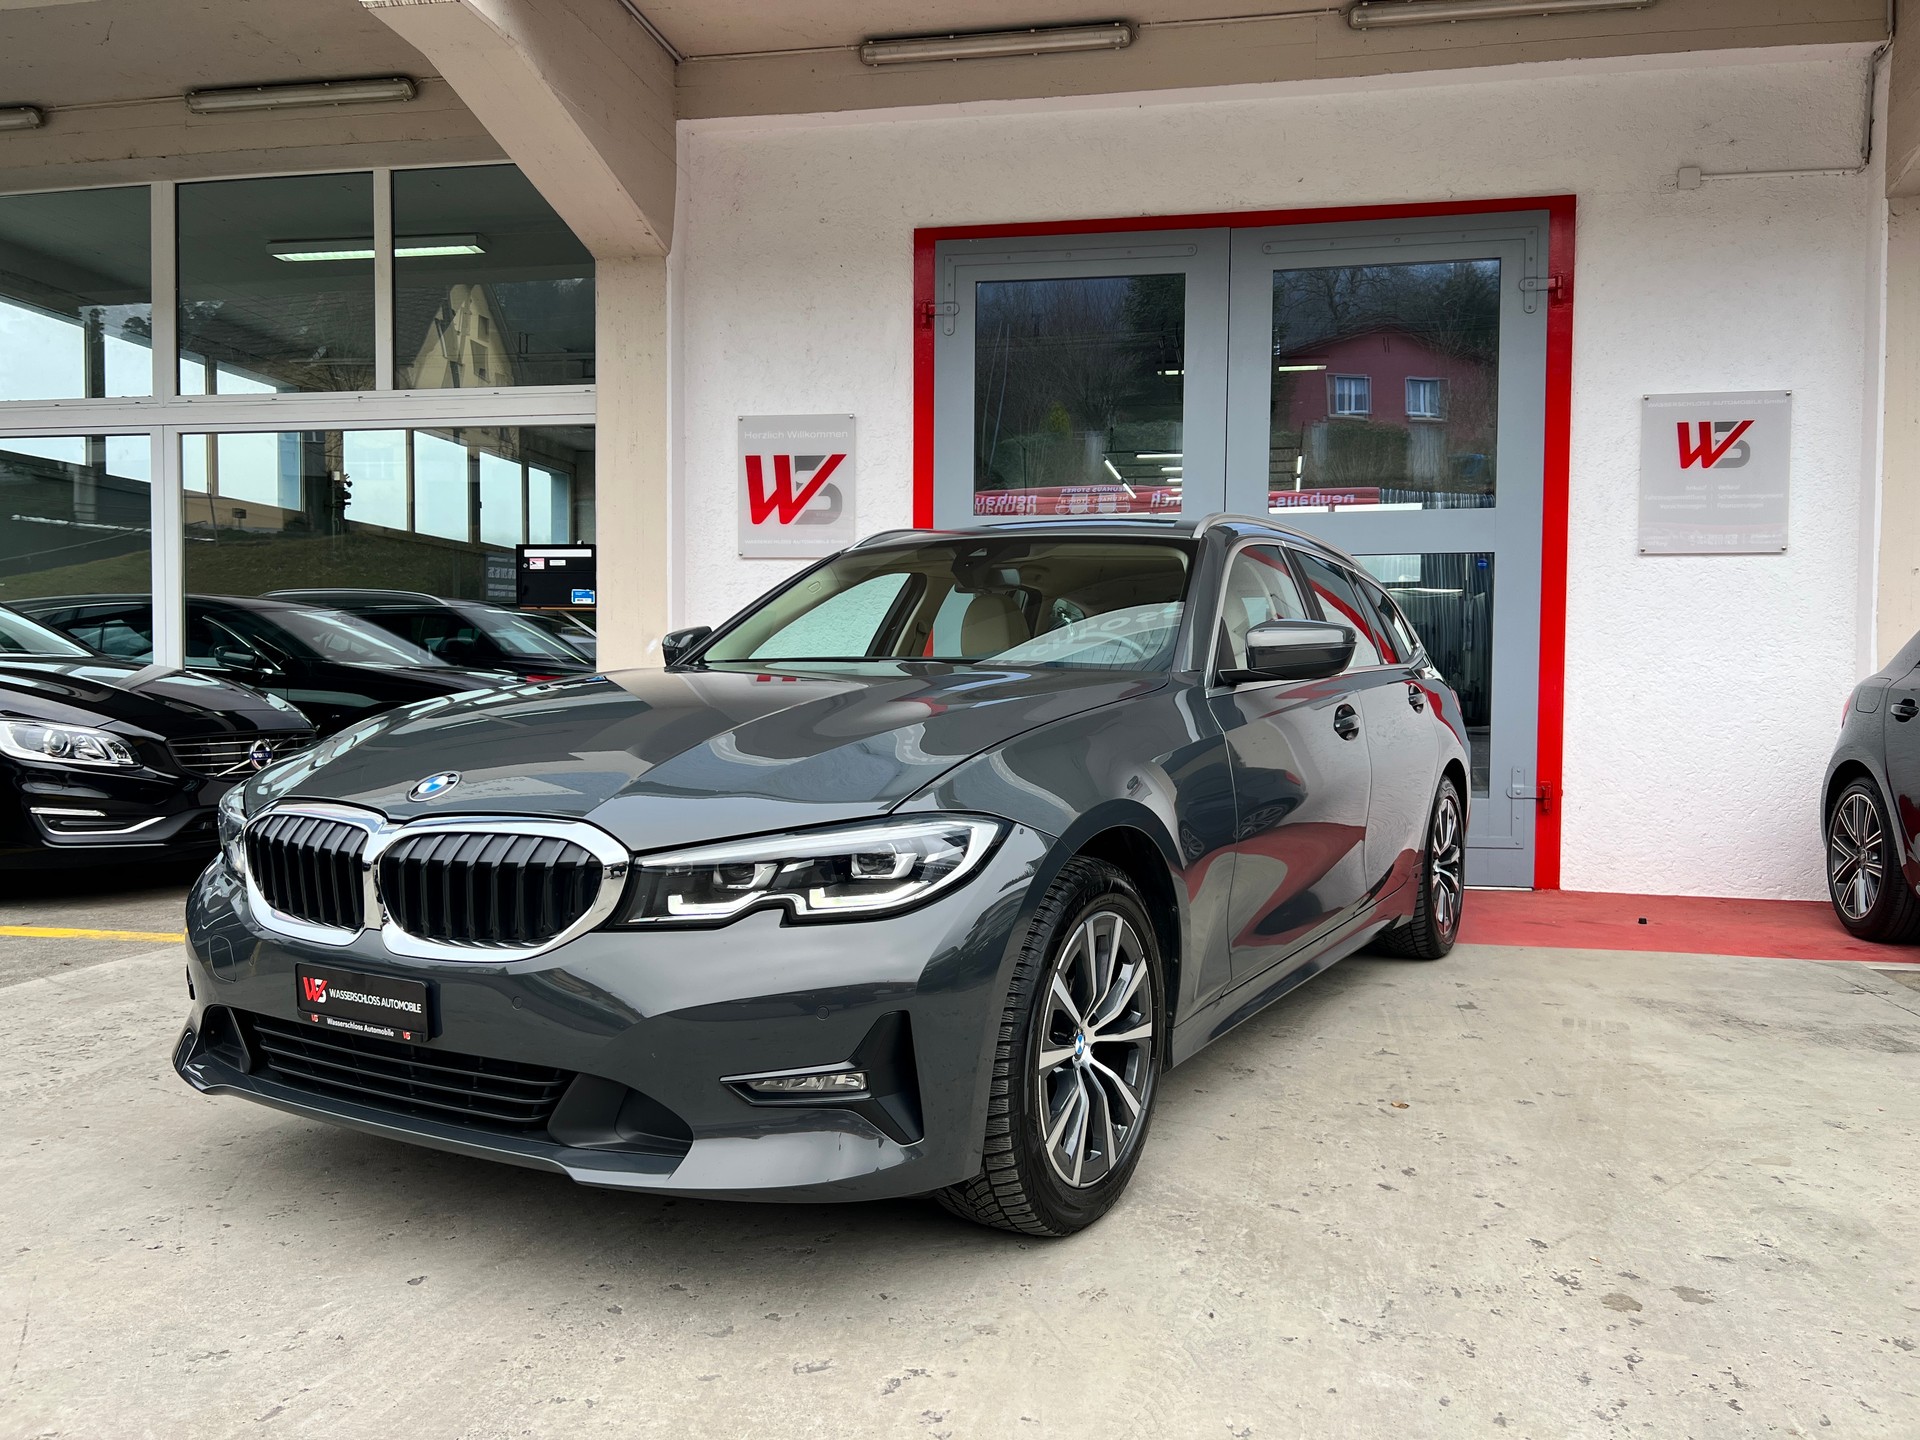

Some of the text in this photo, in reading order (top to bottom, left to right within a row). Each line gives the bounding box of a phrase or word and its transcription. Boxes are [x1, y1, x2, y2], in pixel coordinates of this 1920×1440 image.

[744, 430, 848, 440] Herzlich Willkommen
[329, 988, 422, 1014] WASSERSCHLOSS AUTOMOBILE
[327, 1017, 395, 1037] Wasserschloss Automobile
